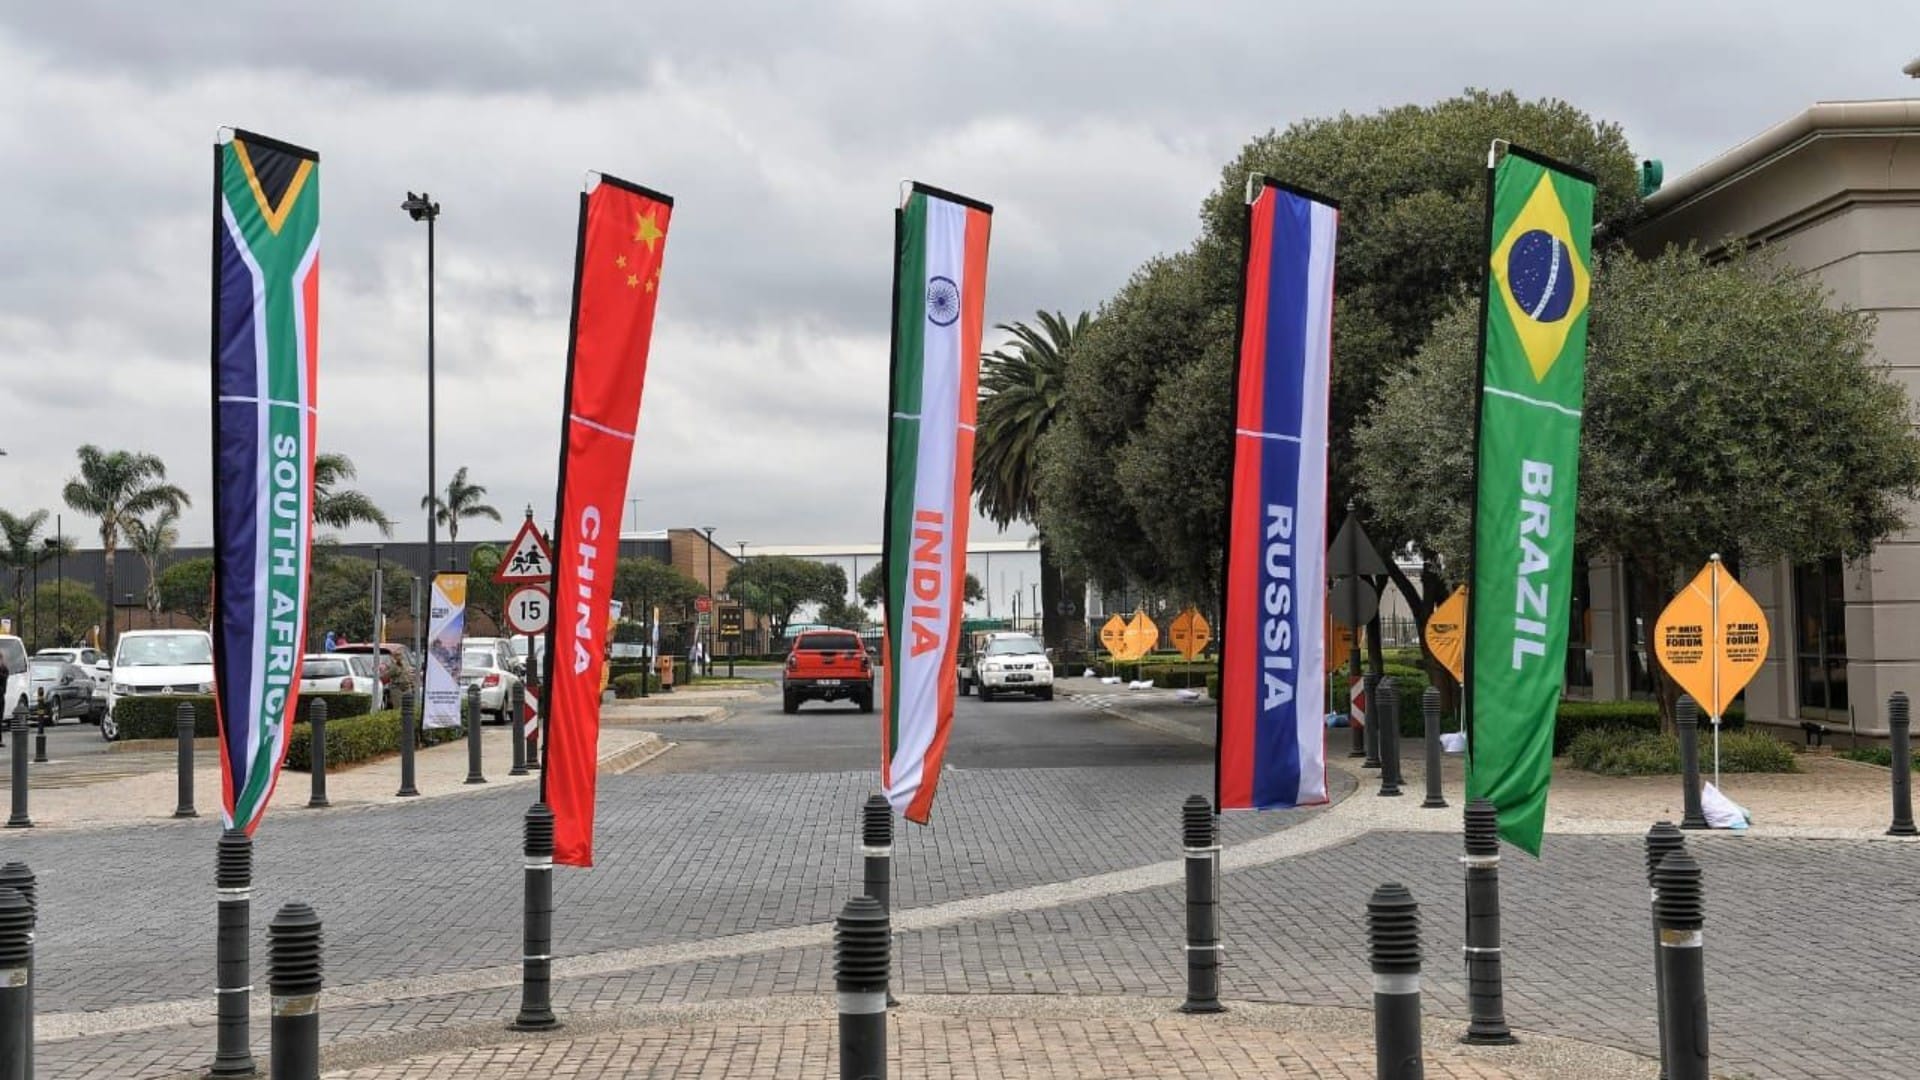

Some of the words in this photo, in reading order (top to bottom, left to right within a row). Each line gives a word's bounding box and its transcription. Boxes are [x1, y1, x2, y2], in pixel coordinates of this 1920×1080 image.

[273, 433, 297, 577] SOUTH
[1512, 459, 1553, 670] BRAZIL
[520, 601, 541, 620] 15
[573, 505, 601, 675] CHINA
[910, 510, 944, 659] INDIA
[1263, 504, 1293, 711] RUSSIA
[1666, 639, 1703, 647] FORUM
[1726, 636, 1758, 645] FORUM
